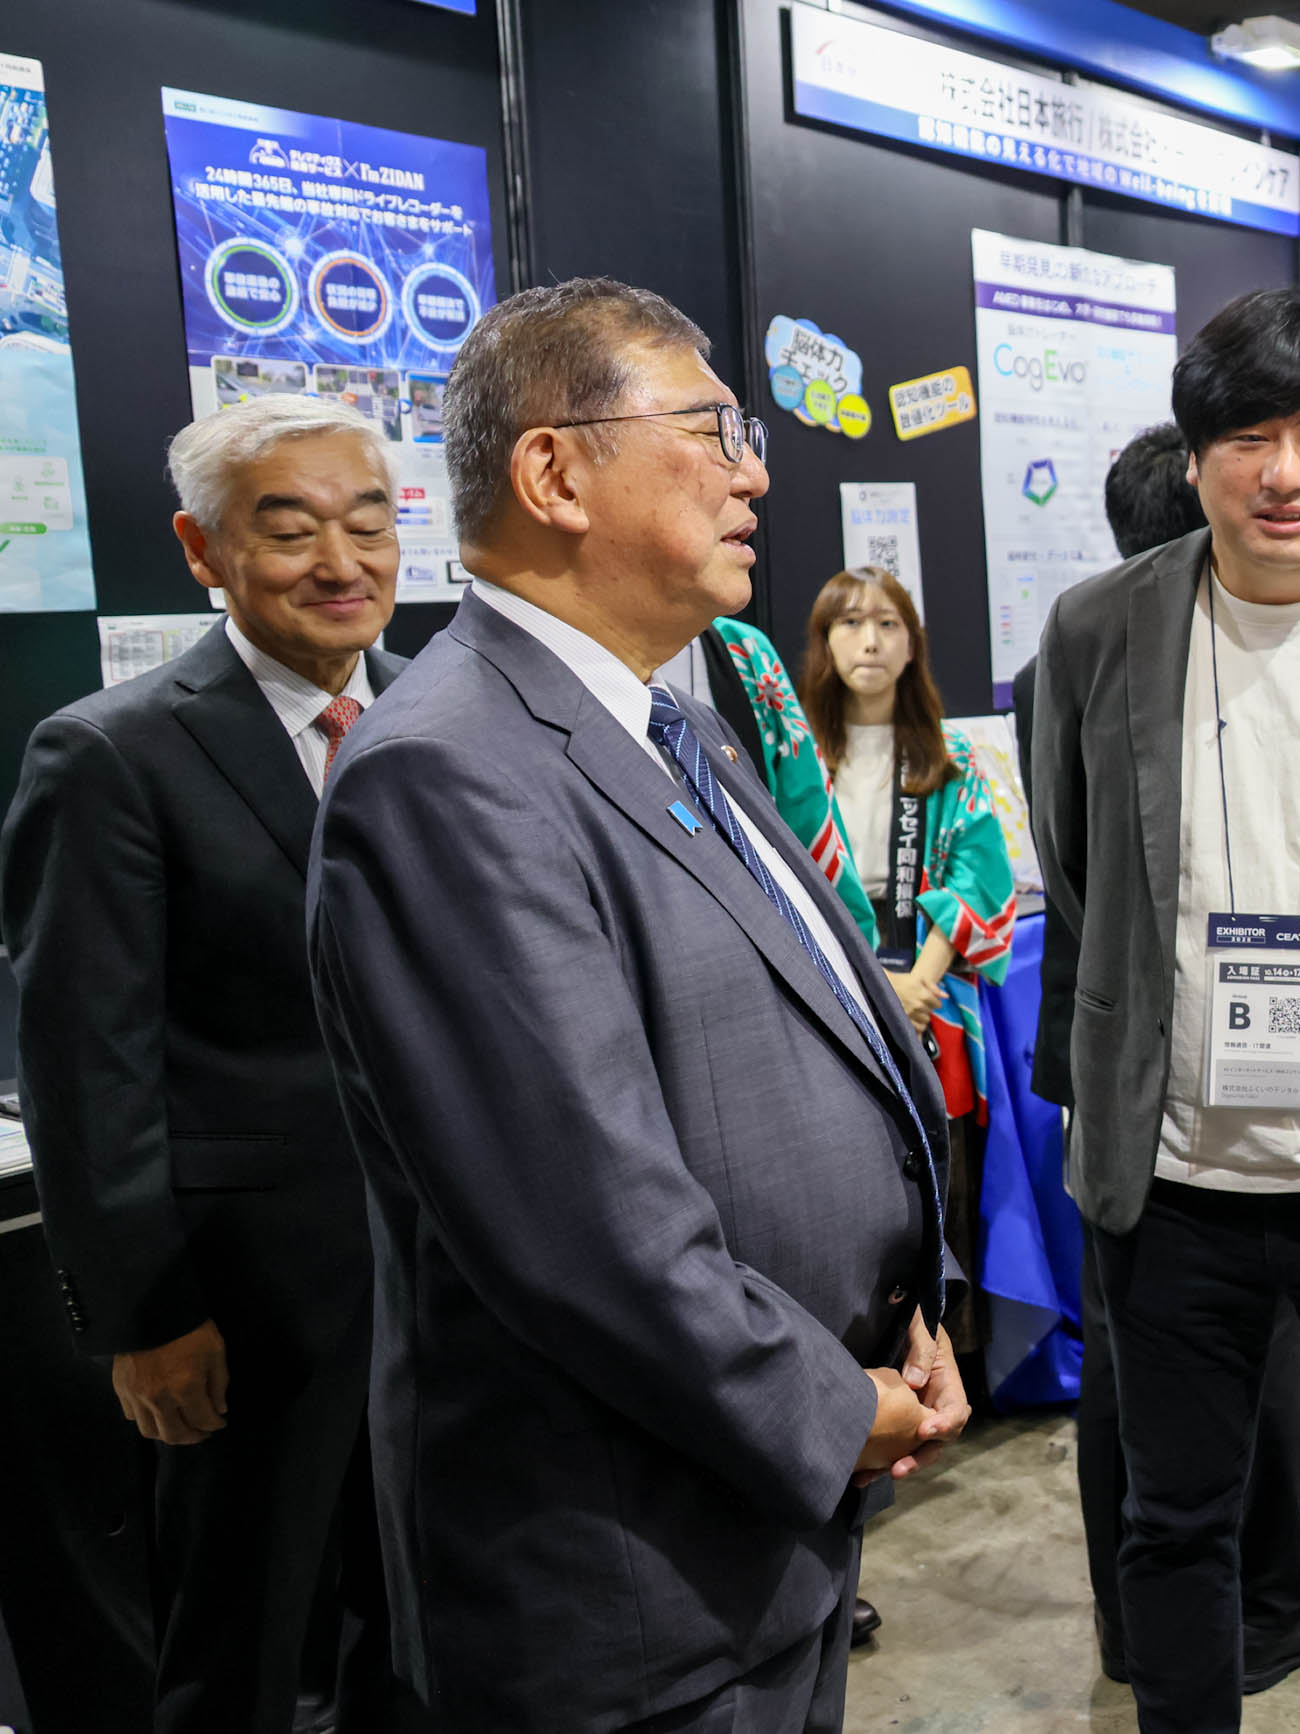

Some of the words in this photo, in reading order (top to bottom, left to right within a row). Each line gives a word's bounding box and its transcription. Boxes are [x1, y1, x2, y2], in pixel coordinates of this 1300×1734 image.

[993, 343, 1087, 391] CogEvo
[1216, 926, 1266, 937] EXHIBITOR
[1228, 1001, 1251, 1031] B
